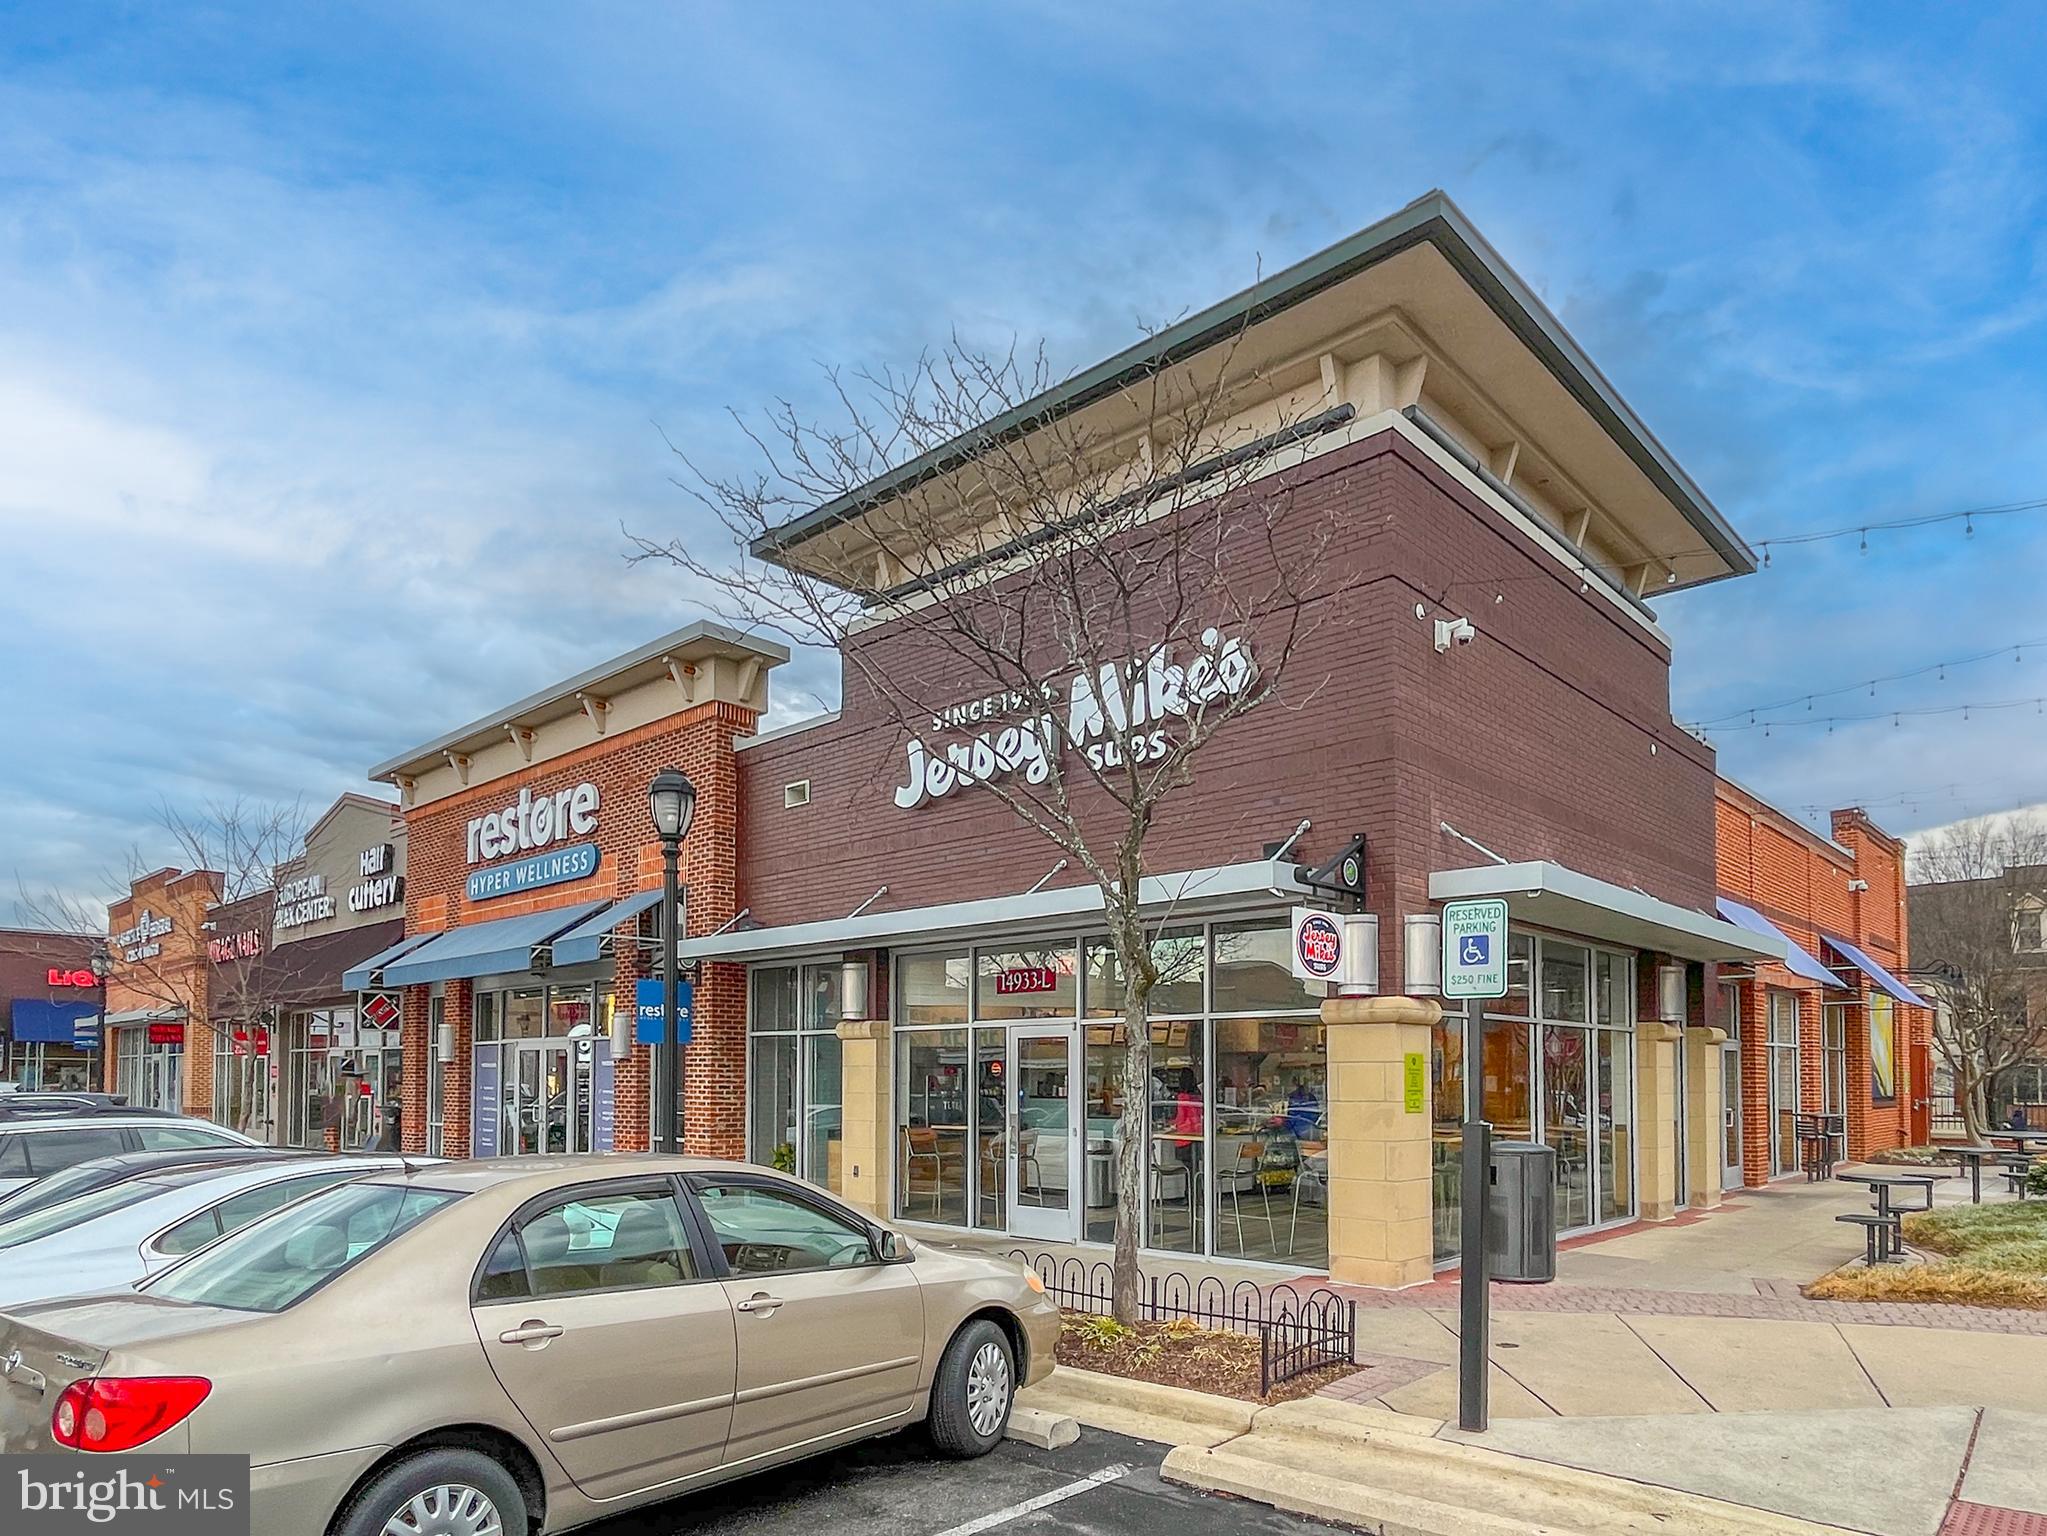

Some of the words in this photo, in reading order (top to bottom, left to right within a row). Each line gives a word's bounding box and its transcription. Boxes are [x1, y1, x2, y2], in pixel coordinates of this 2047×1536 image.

[932, 700, 993, 732] SINCE
[894, 713, 1055, 809] Jersey
[467, 782, 601, 865] restore
[360, 844, 386, 877] Hair
[470, 870, 511, 897] HYPER
[515, 850, 589, 885] WELLNESS
[296, 896, 331, 925] CENTER
[1449, 907, 1501, 922] RESERVED
[1303, 923, 1338, 951] Jersey
[1453, 921, 1497, 935] PARKING
[1001, 970, 1052, 993] 14933-L
[1451, 974, 1474, 985] $250
[1477, 974, 1499, 985] FINE
